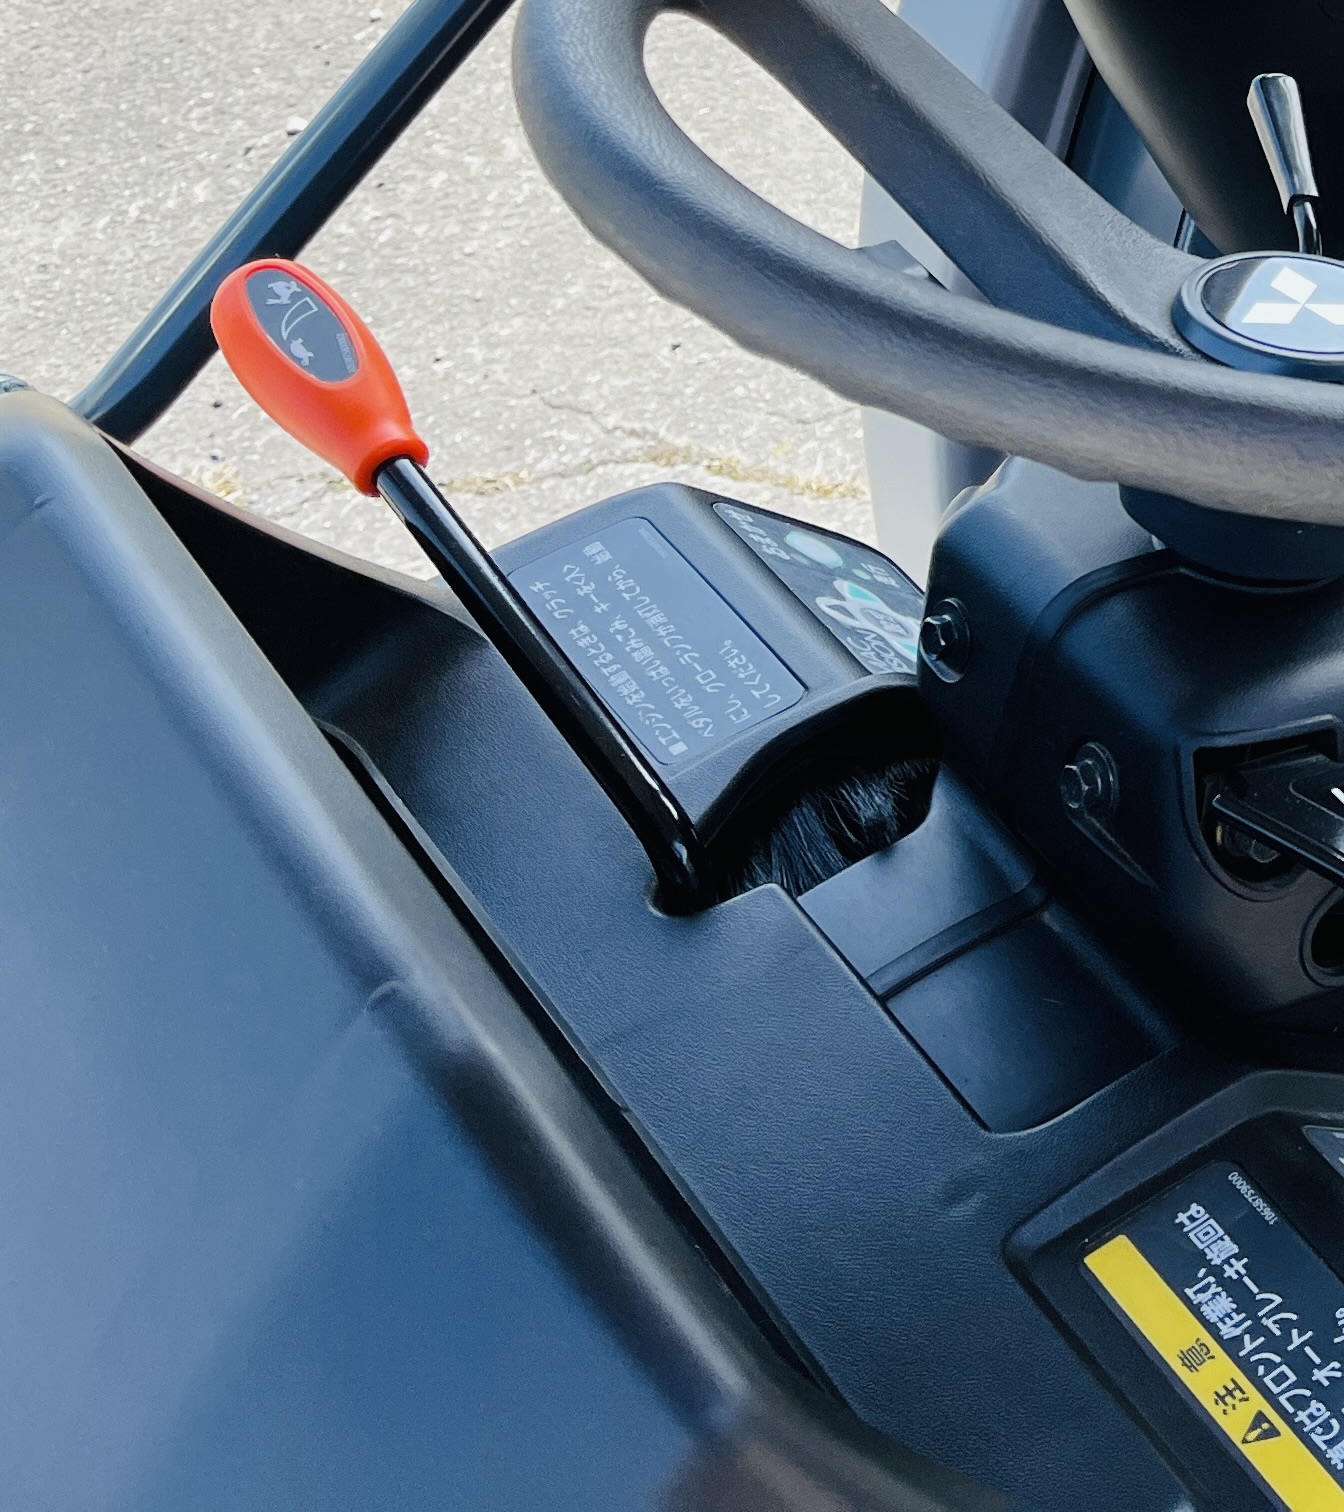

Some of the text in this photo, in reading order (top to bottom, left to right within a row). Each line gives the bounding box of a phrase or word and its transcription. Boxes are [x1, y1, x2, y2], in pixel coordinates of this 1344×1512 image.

[717, 637, 781, 710] してください。
[1173, 1335, 1251, 1416] 注意
